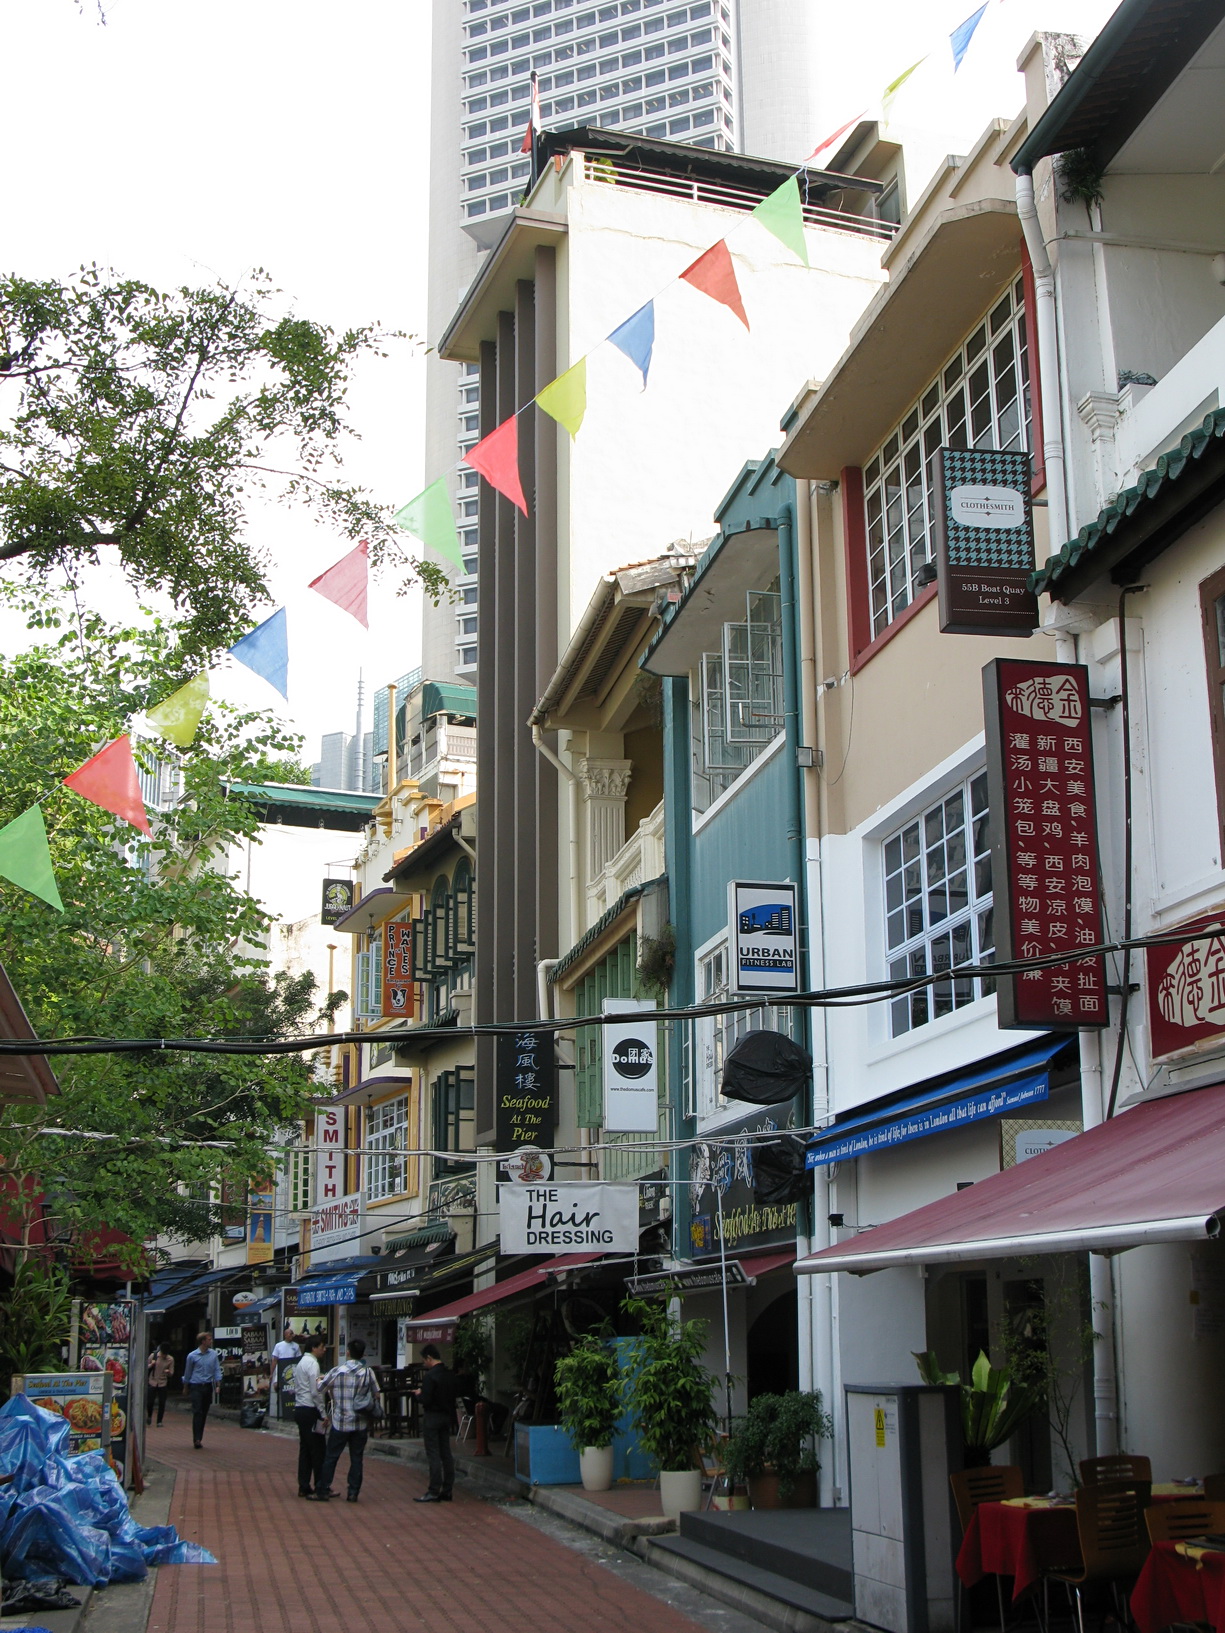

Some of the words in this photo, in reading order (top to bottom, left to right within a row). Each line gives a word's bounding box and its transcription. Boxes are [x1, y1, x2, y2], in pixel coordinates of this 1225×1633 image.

[960, 501, 1015, 511] CLOTHESMITH
[961, 583, 979, 592] 55B
[981, 584, 1000, 593] Boat
[1003, 585, 1026, 594] Quay
[979, 596, 1002, 605] Level
[386, 925, 397, 976] PRINCE
[400, 929, 412, 975] WALES
[740, 946, 793, 959] URBAN
[742, 959, 774, 967] FITNESS
[612, 1053, 654, 1064] Domus
[501, 1095, 550, 1112] Seafood
[510, 1113, 521, 1124] At
[525, 1113, 542, 1125] The
[918, 1119, 924, 1132] is
[923, 1117, 929, 1129] in
[930, 1111, 948, 1128] London
[956, 1105, 967, 1120] that
[967, 1101, 976, 1119] life
[977, 1102, 987, 1113] can
[511, 1127, 538, 1141] Pier
[525, 1189, 559, 1203] THE
[320, 1201, 349, 1234] SMITHS
[526, 1202, 600, 1230] Hair
[526, 1229, 614, 1245] DRESSING
